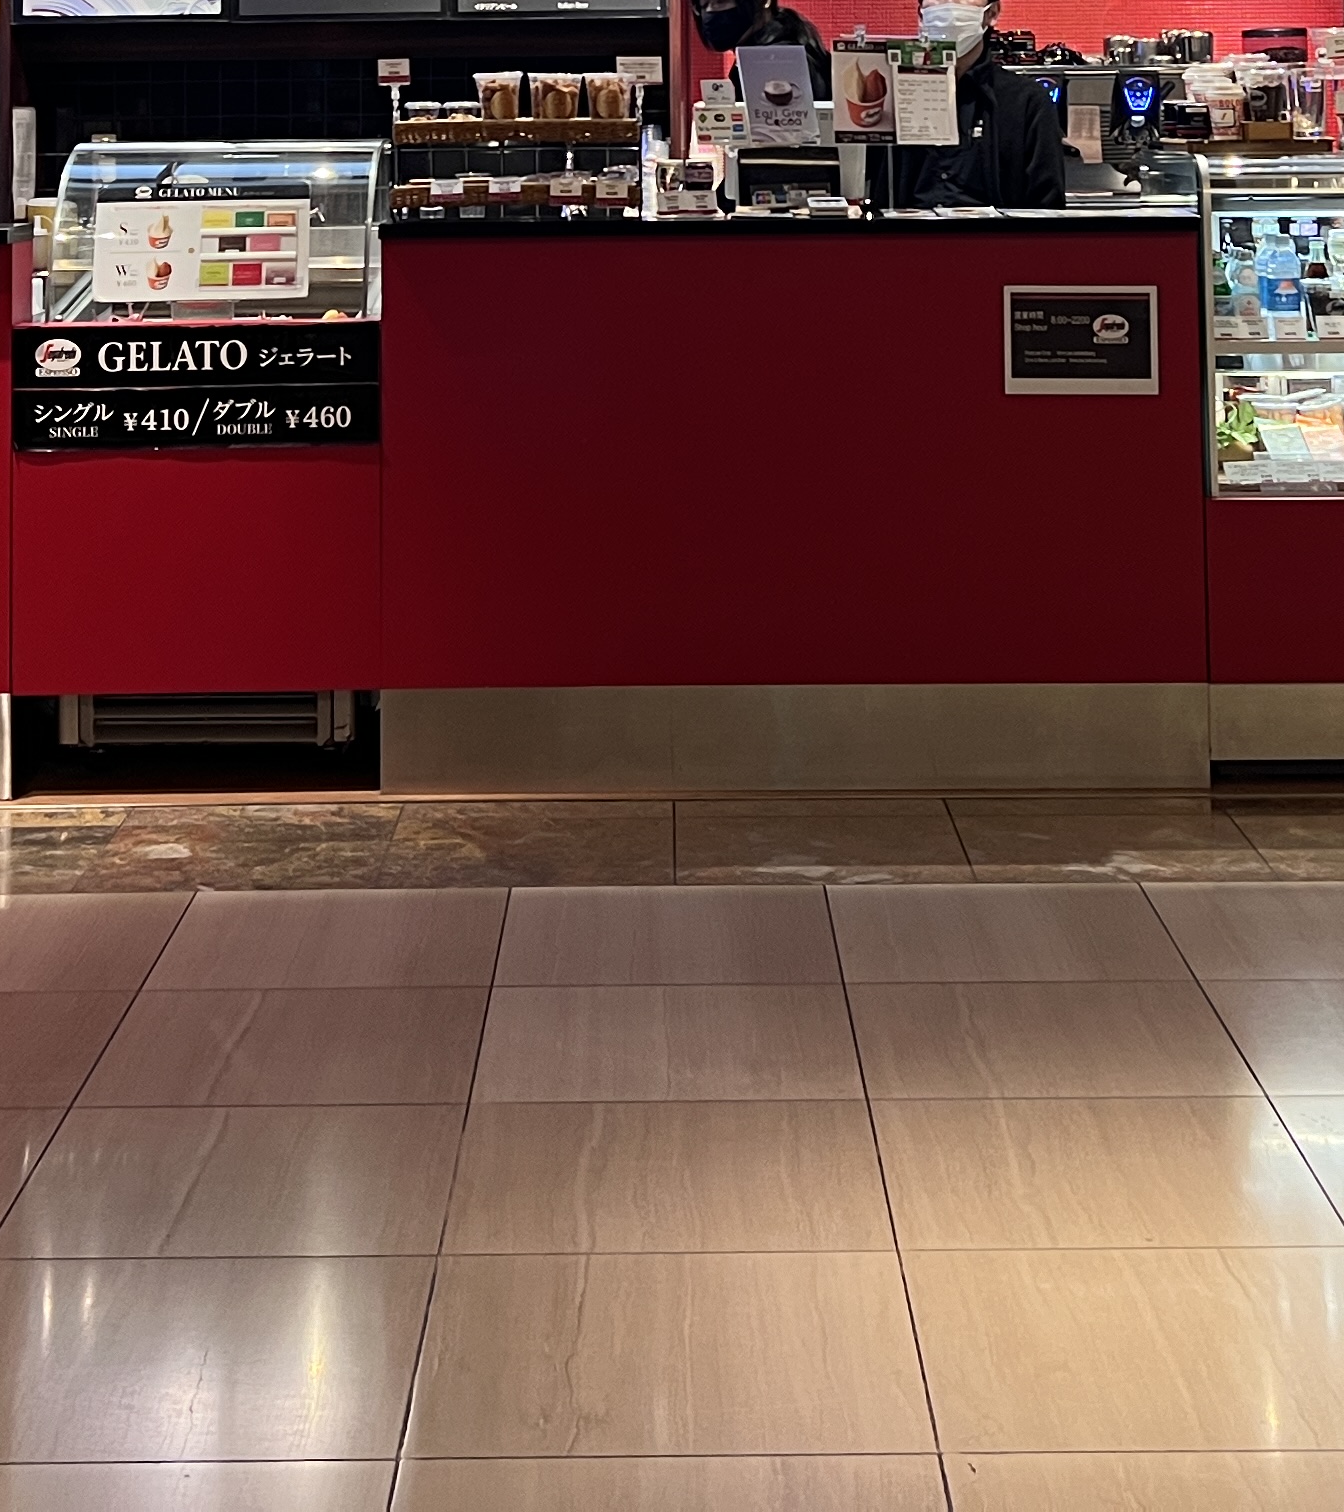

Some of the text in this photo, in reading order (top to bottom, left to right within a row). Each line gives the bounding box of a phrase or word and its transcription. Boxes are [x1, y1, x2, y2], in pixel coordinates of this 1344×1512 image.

[754, 108, 809, 120] Earl Grey
[158, 186, 240, 199] GELATO MENU
[97, 339, 248, 373] GELATO
[258, 346, 352, 369] ジェラート
[33, 402, 115, 425] シングル
[123, 408, 190, 432] ¥410
[212, 397, 277, 421] ダブル
[285, 405, 352, 429] ¥460
[48, 426, 99, 439] SINGLE
[216, 423, 273, 436] DOUBLE
